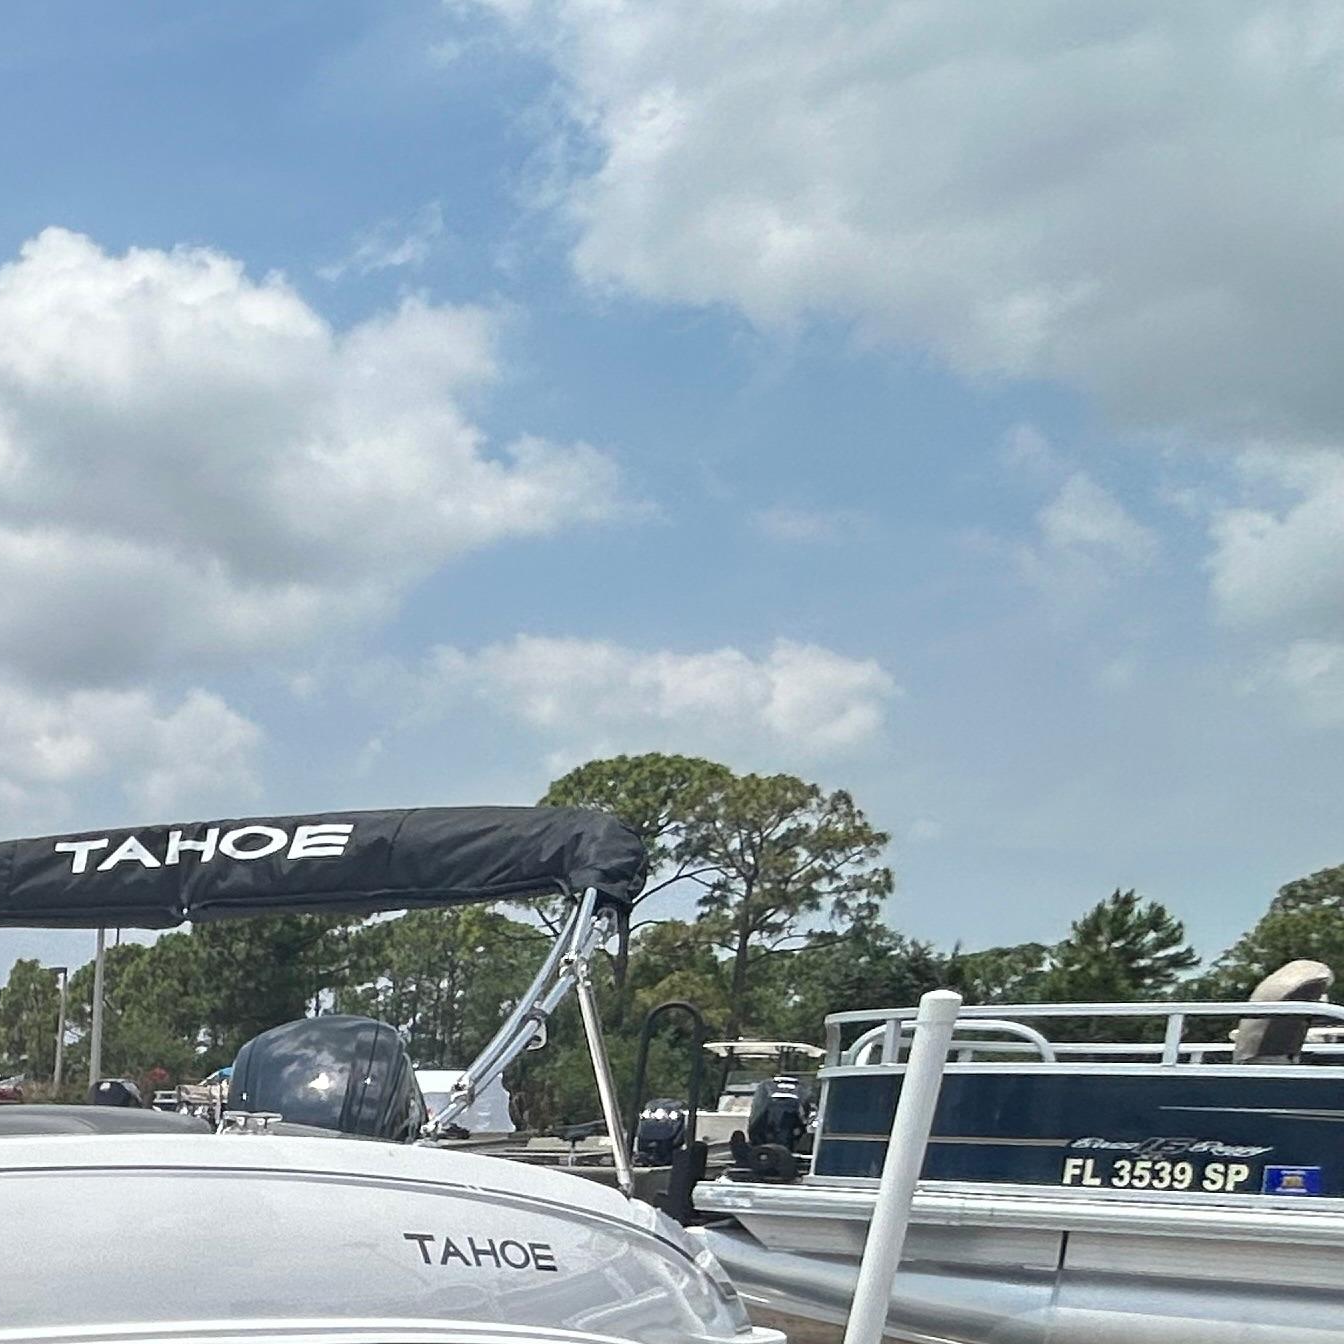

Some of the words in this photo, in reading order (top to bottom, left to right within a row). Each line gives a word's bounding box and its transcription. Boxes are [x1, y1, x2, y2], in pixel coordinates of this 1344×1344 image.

[55, 824, 354, 873] TAHOE
[1062, 1158, 1102, 1186] FL
[1112, 1160, 1194, 1190] 3539
[1202, 1163, 1250, 1192] SP
[403, 1232, 558, 1272] TAHOE
